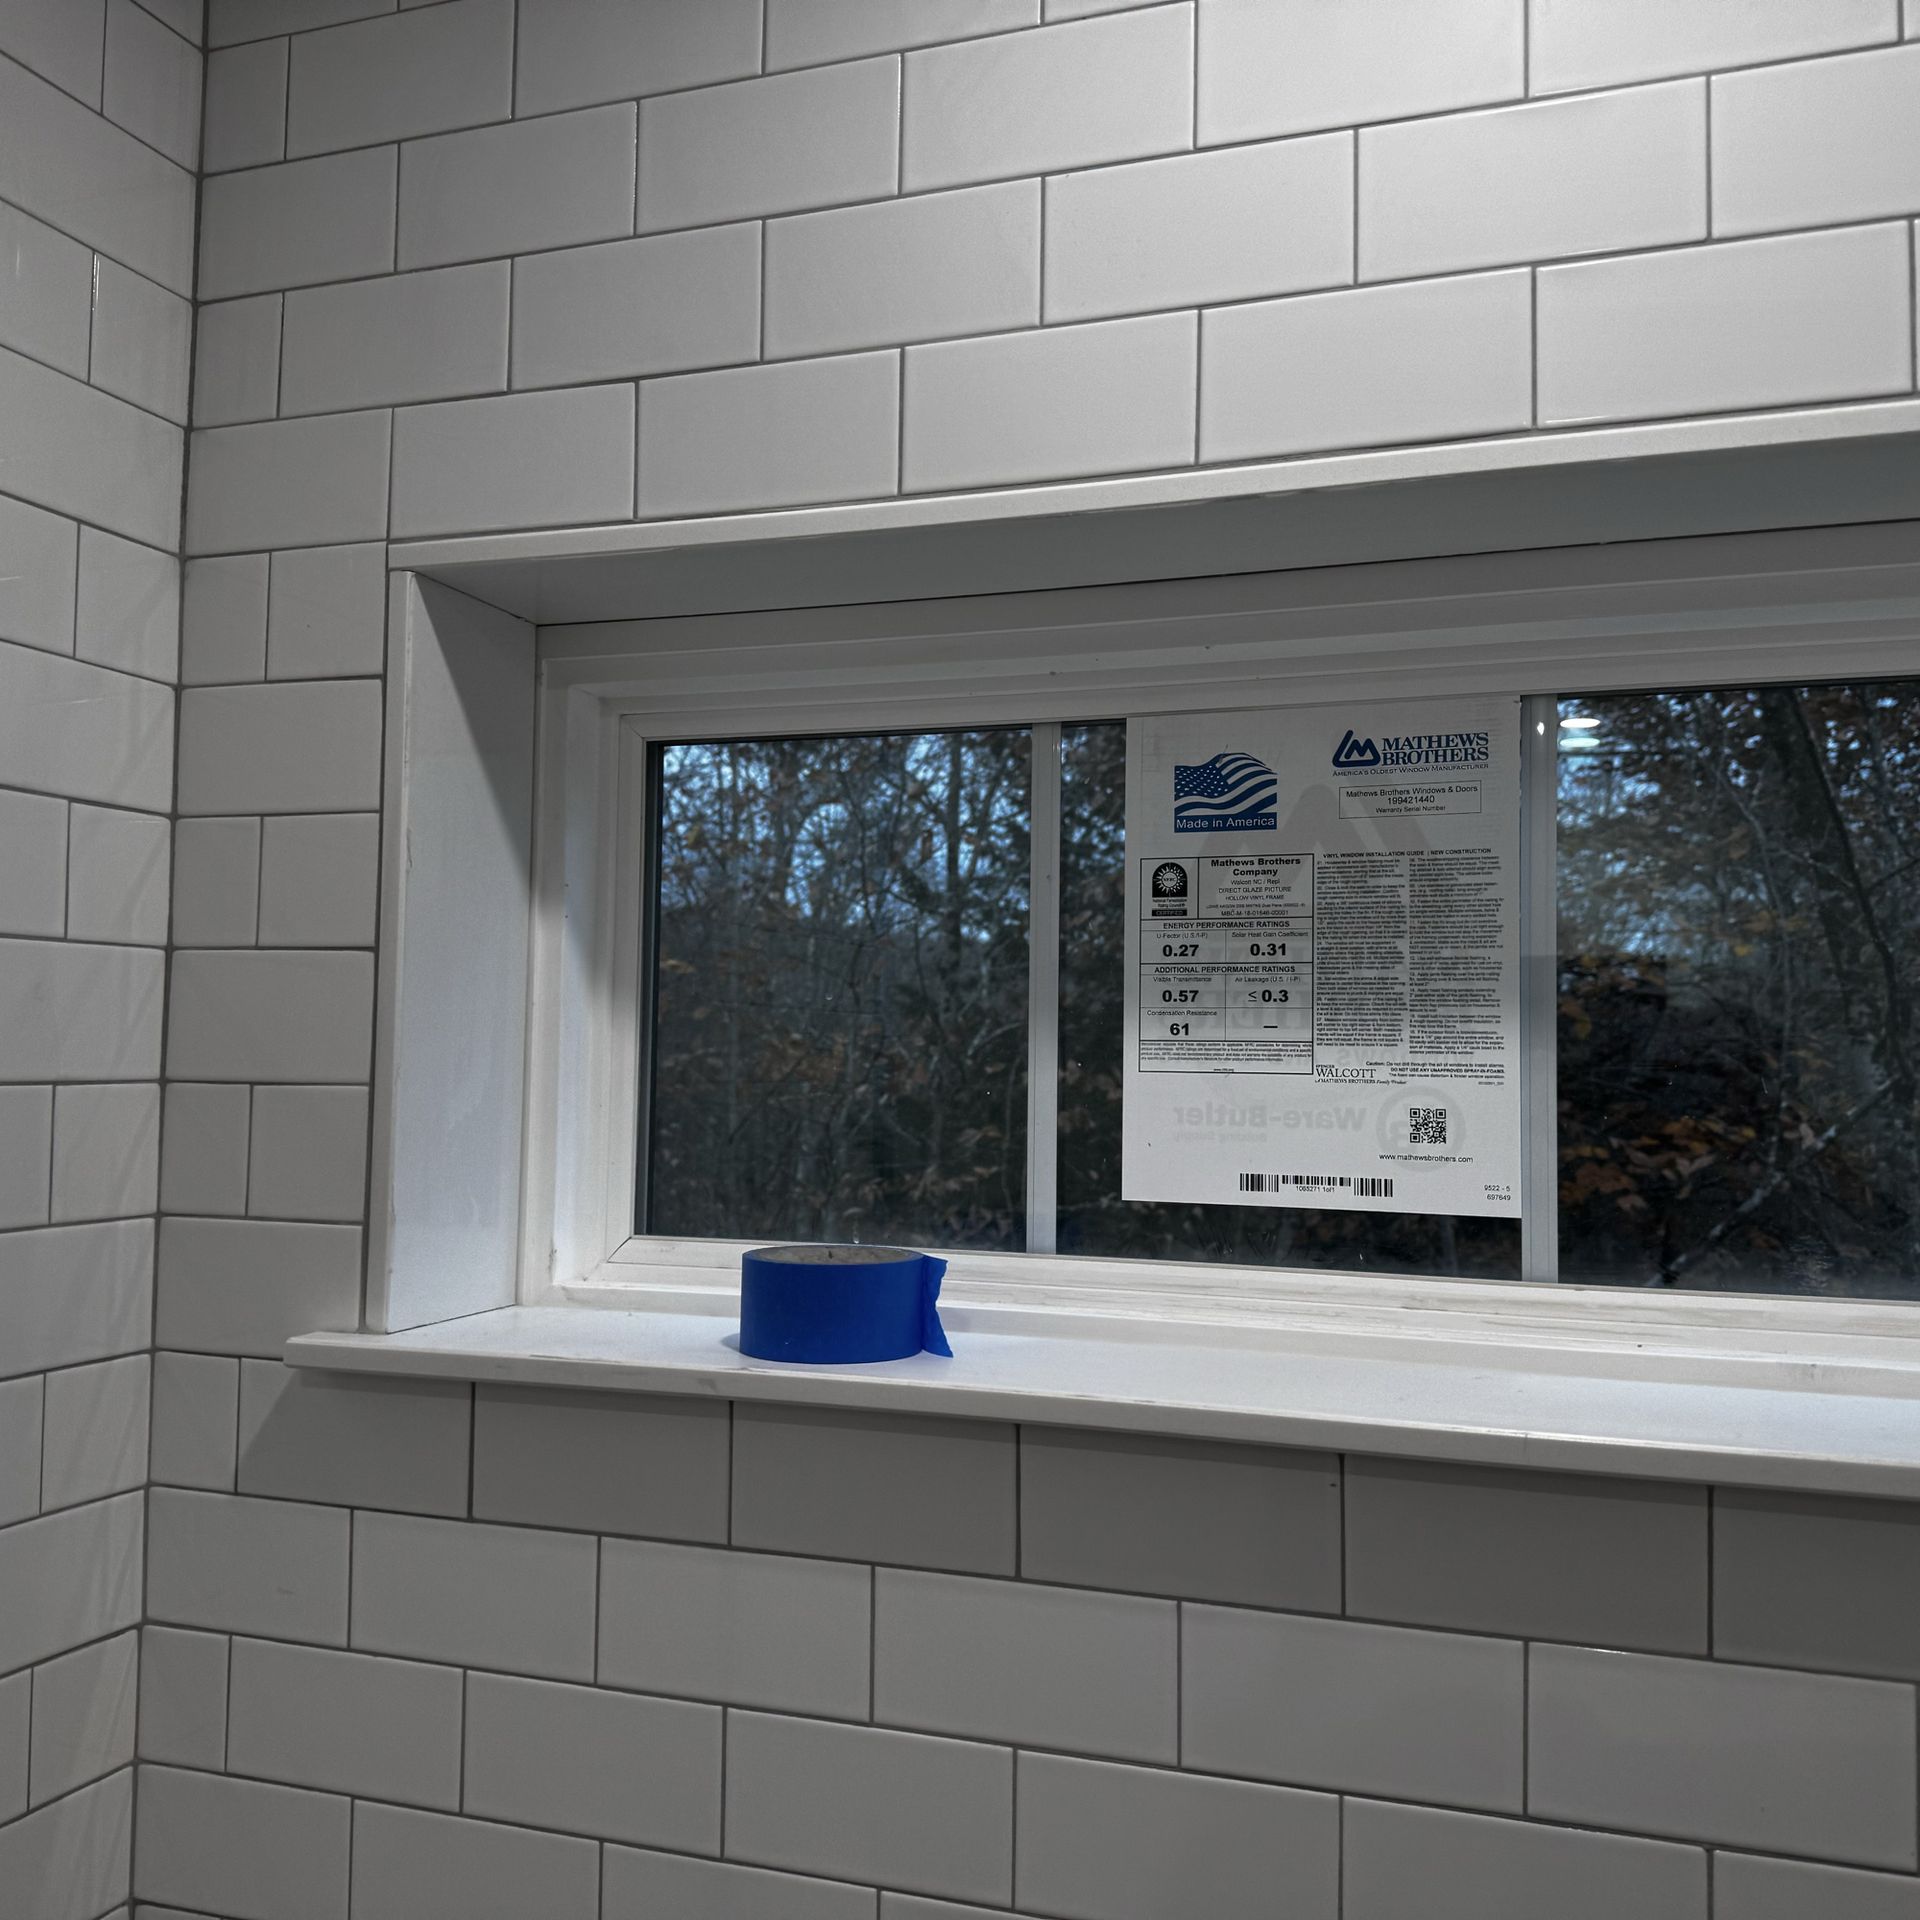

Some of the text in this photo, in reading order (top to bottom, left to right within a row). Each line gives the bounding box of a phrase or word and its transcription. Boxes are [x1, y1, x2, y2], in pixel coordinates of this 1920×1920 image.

[1382, 732, 1489, 750] MATHEWS
[1382, 746, 1489, 766] BROTHERS
[1332, 764, 1489, 777] AMERICA'S OLDEST WINDOW MANUFACTURER
[1346, 790, 1378, 798] Mathews
[1380, 788, 1410, 797] Brothers
[1412, 787, 1446, 795] Windows
[1456, 785, 1478, 793] Doors
[1388, 795, 1435, 806] 199421440
[1376, 806, 1402, 814] Warranty
[1176, 816, 1275, 829] Made in America
[1210, 857, 1301, 867] Mathews Brothers
[1232, 868, 1278, 877] Company
[1196, 921, 1254, 929] PERFORMANCE
[1256, 920, 1290, 928] RATINGS
[1162, 944, 1200, 958] 0.27
[1250, 943, 1286, 956] 0.31
[1154, 966, 1199, 974] ADDITIONAL
[1245, 976, 1269, 984] Leakage
[1162, 990, 1199, 1003] 0.57
[1261, 989, 1289, 1003] 0.3
[1169, 1023, 1190, 1036] 61
[1316, 1068, 1376, 1079] WALCOTT
[1378, 1152, 1474, 1164] www.mathewsbrothers.com
[1484, 1184, 1500, 1192] 9522
